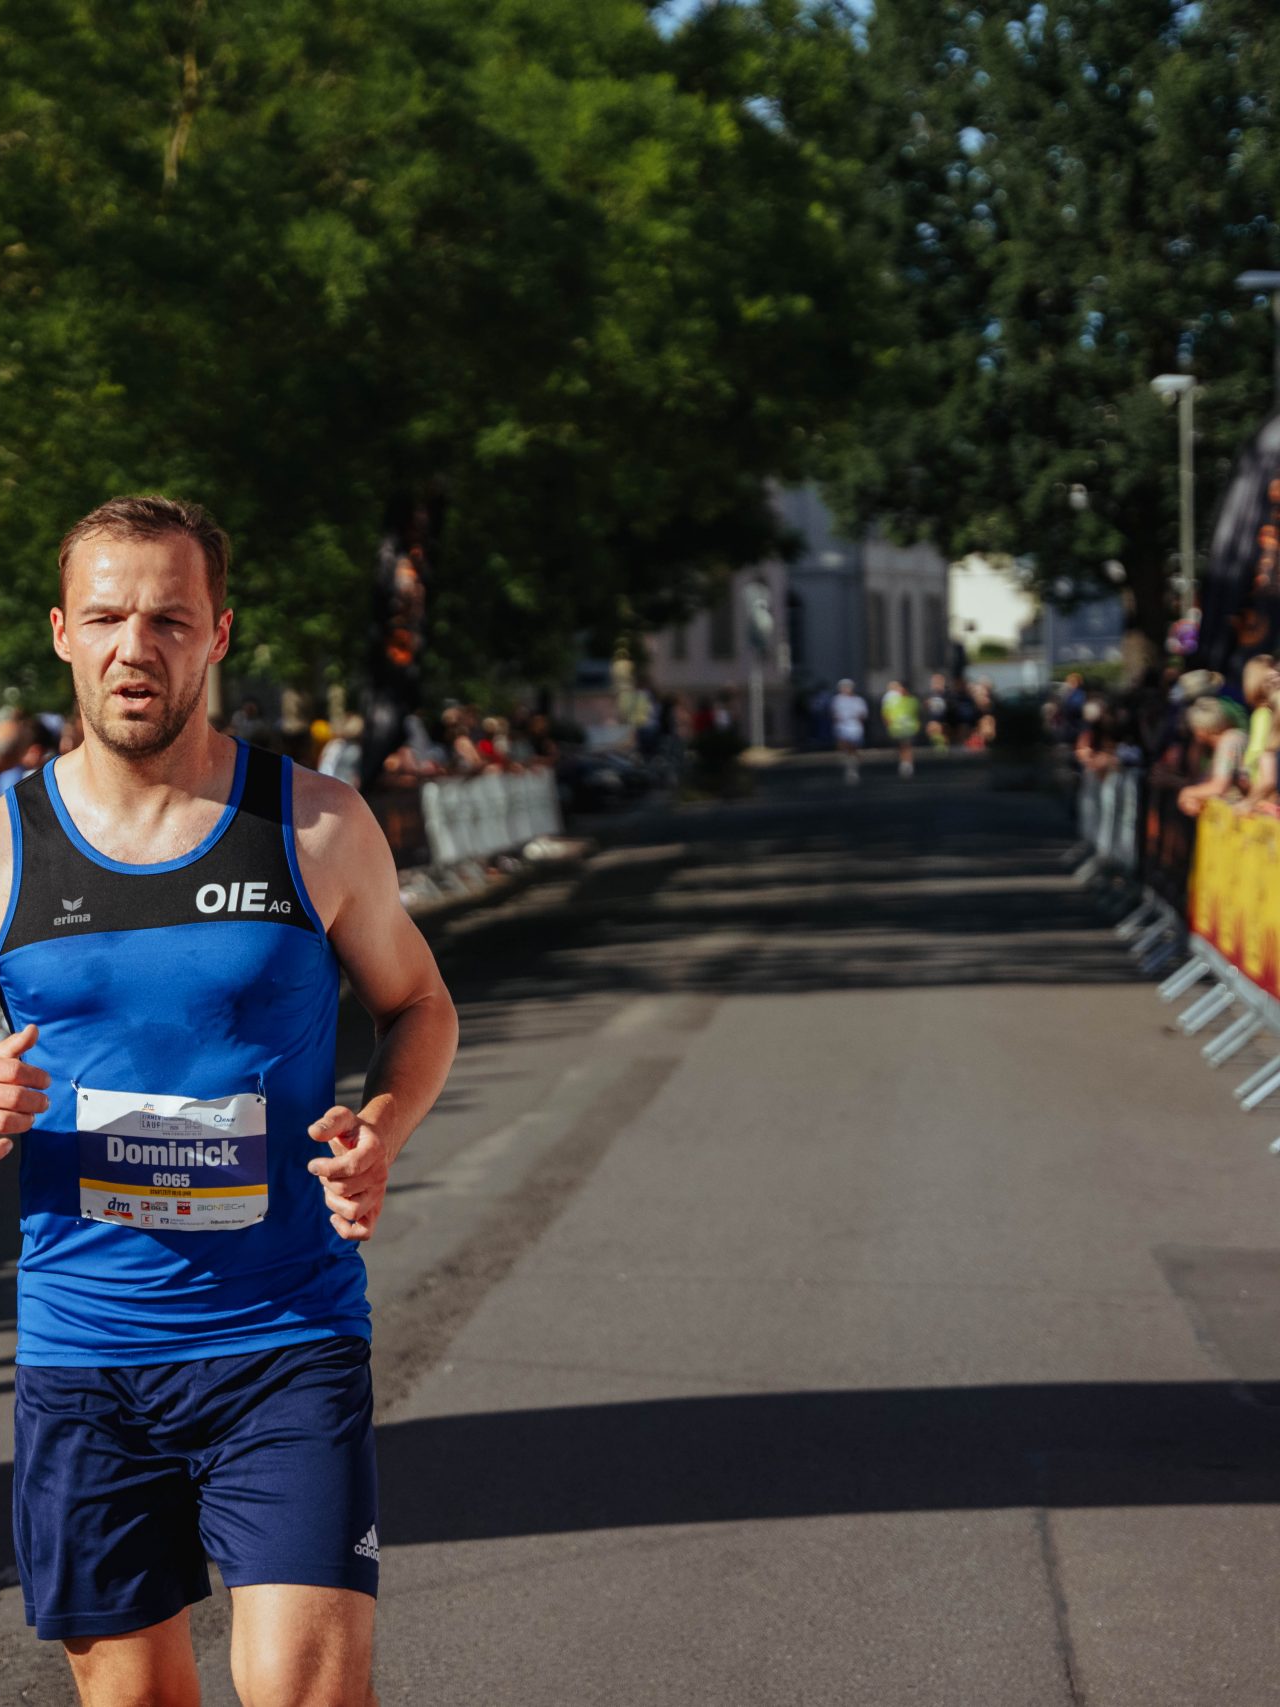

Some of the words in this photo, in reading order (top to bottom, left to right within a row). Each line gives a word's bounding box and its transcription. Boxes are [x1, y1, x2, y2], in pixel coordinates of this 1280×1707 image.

[195, 882, 268, 914] OIE
[268, 901, 291, 914] AG
[53, 912, 91, 926] erima
[141, 1120, 161, 1129] LAUF
[107, 1136, 239, 1167] Dominick
[152, 1172, 191, 1187] 6065
[107, 1197, 130, 1212] dm
[196, 1202, 246, 1211] BIONTECH
[354, 1544, 380, 1562] adida
